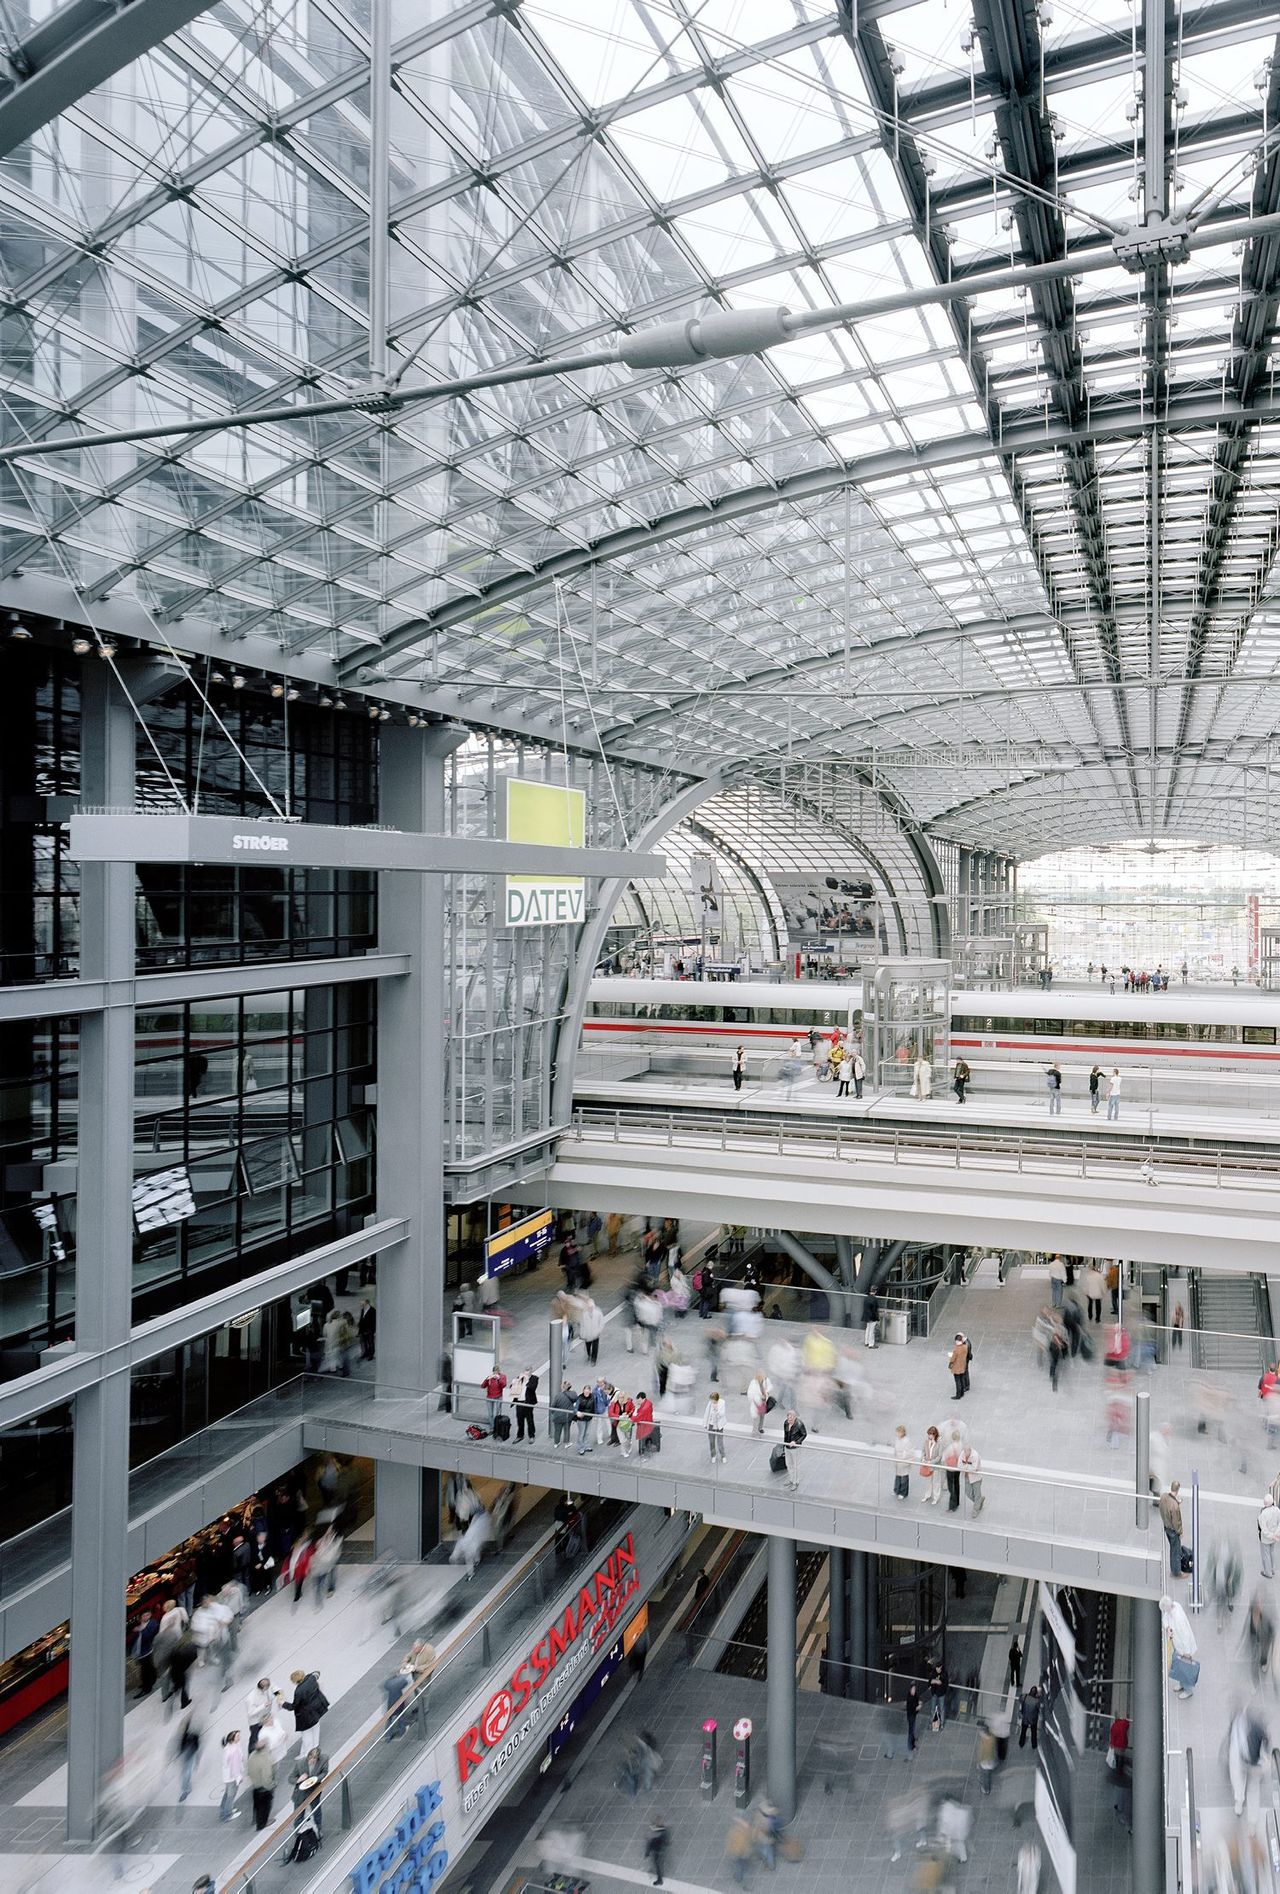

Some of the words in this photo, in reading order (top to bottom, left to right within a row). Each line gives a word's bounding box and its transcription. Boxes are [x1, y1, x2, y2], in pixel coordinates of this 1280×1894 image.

[232, 835, 289, 851] STRÖER
[507, 889, 583, 923] DATEV
[824, 1011, 830, 1019] 2
[986, 1018, 992, 1026] 2
[456, 1531, 635, 1784] ROSSMANN
[464, 1772, 490, 1813] über
[491, 1733, 520, 1776] 1200
[520, 1718, 532, 1741] x
[530, 1707, 542, 1727] in
[540, 1638, 590, 1713] Deutschland
[349, 1780, 443, 1894] Bank
